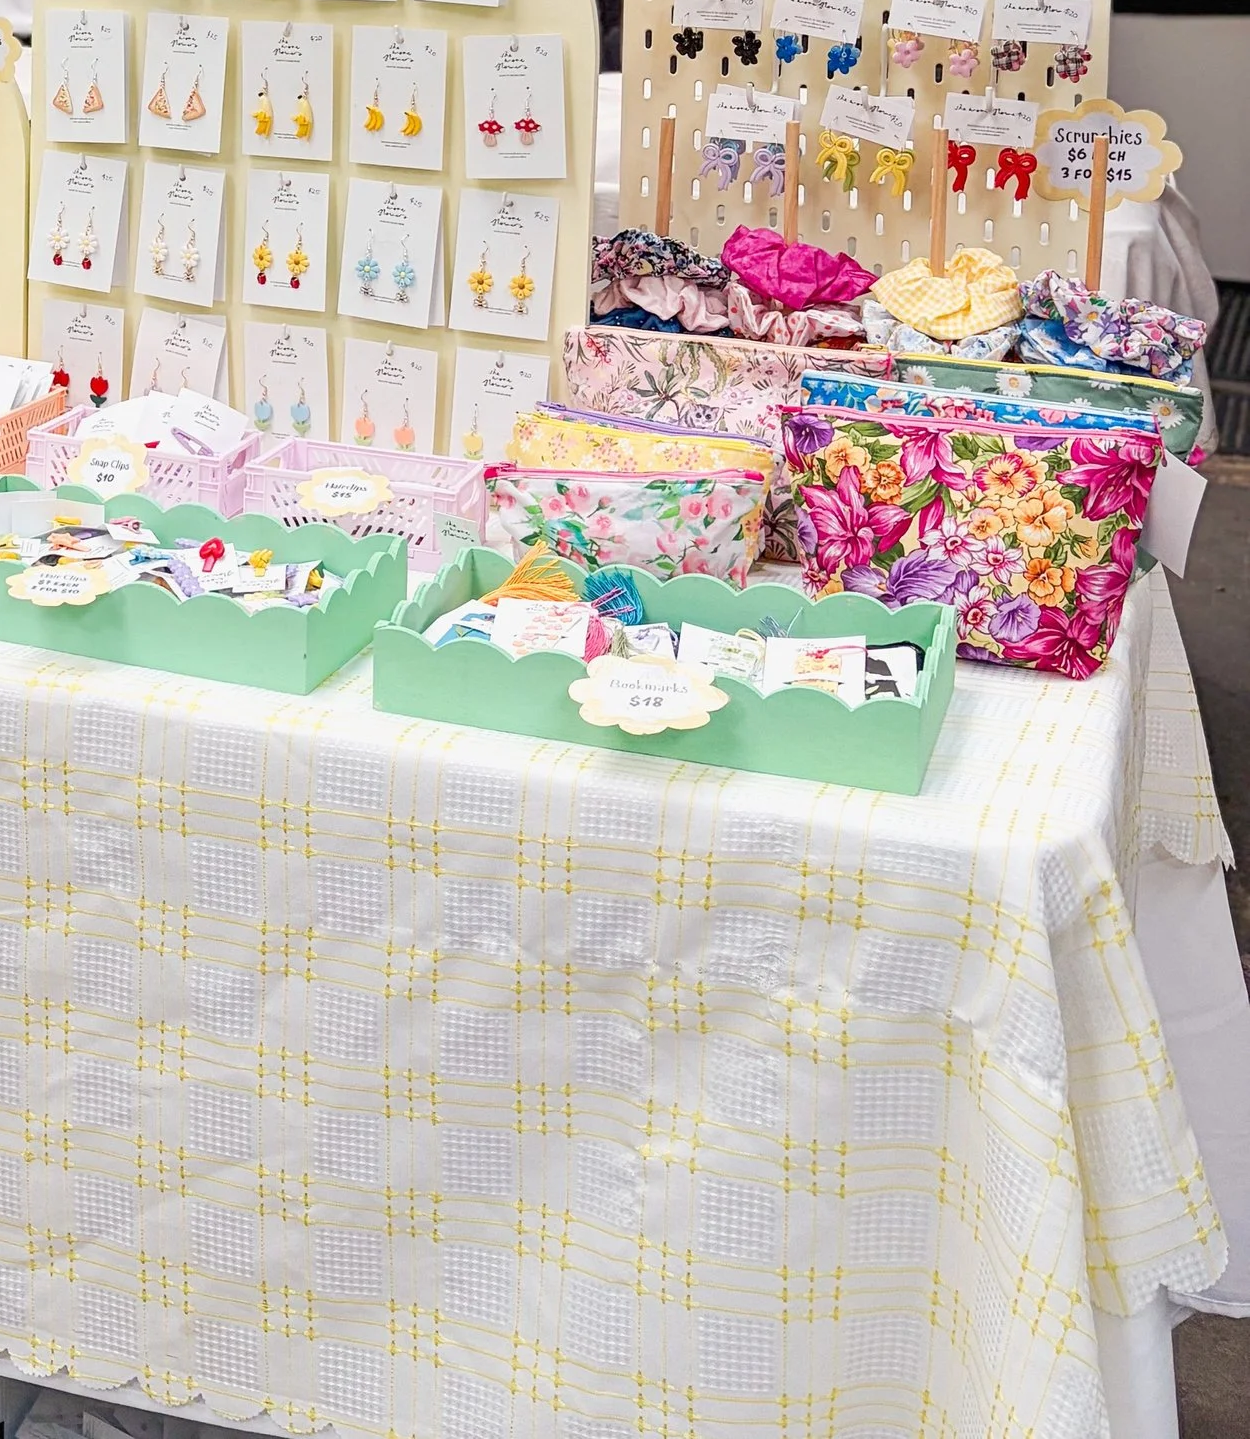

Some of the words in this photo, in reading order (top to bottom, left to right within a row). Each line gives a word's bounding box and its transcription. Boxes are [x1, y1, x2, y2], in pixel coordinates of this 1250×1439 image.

[1055, 125, 1142, 146] Scrunhies
[1068, 147, 1087, 163] $6
[1061, 167, 1070, 178] 3
[1074, 168, 1092, 179] FO
[1106, 167, 1132, 183] $15
[90, 458, 109, 469] Snap
[111, 460, 130, 471] Clips
[96, 472, 115, 482] $10
[609, 679, 689, 693] Bookmarks
[629, 695, 664, 708] $18
